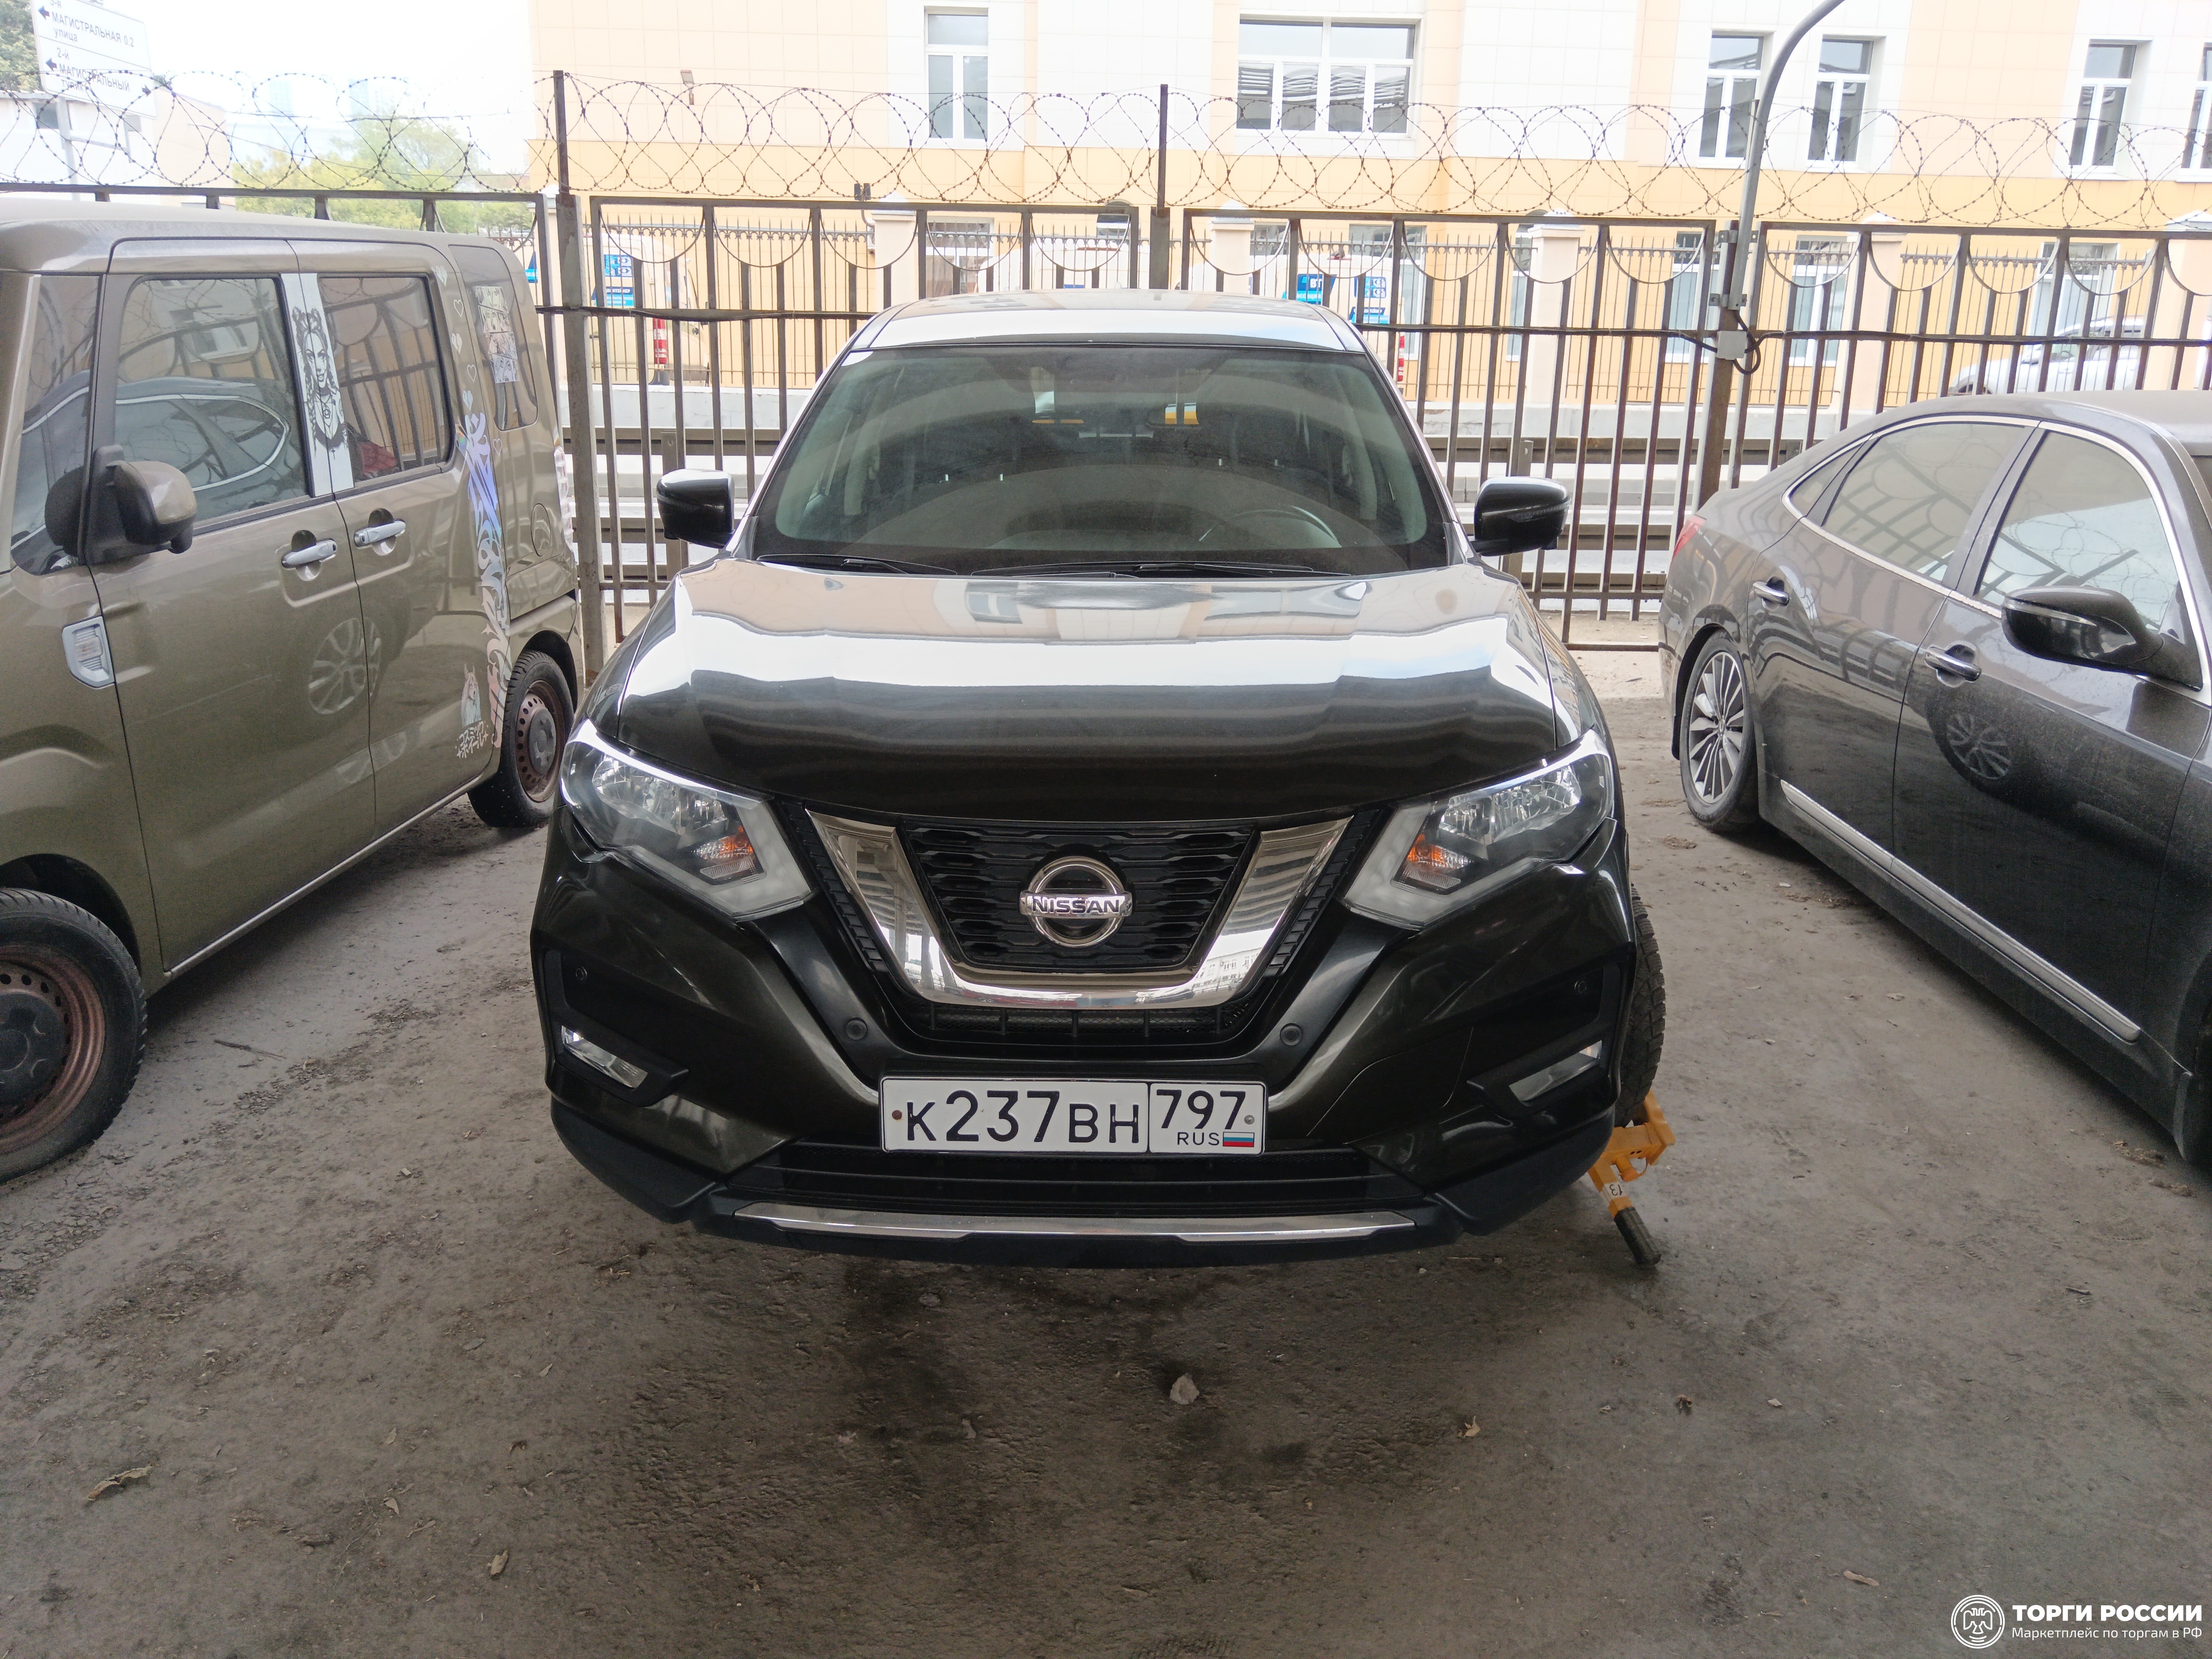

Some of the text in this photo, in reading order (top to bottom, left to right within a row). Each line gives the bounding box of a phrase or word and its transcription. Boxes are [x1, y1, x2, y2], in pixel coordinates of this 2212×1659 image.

[52, 12, 134, 47] МАГИСТРАЛЬНАЯ 0.2
[54, 28, 78, 42] улица
[57, 47, 69, 60] 2-й
[59, 63, 130, 92] МАГИСТРАЛЬНЫЙ
[1032, 896, 1120, 914] NISSAN
[1155, 1089, 1246, 1129] 797
[1177, 1132, 1220, 1146] RUS
